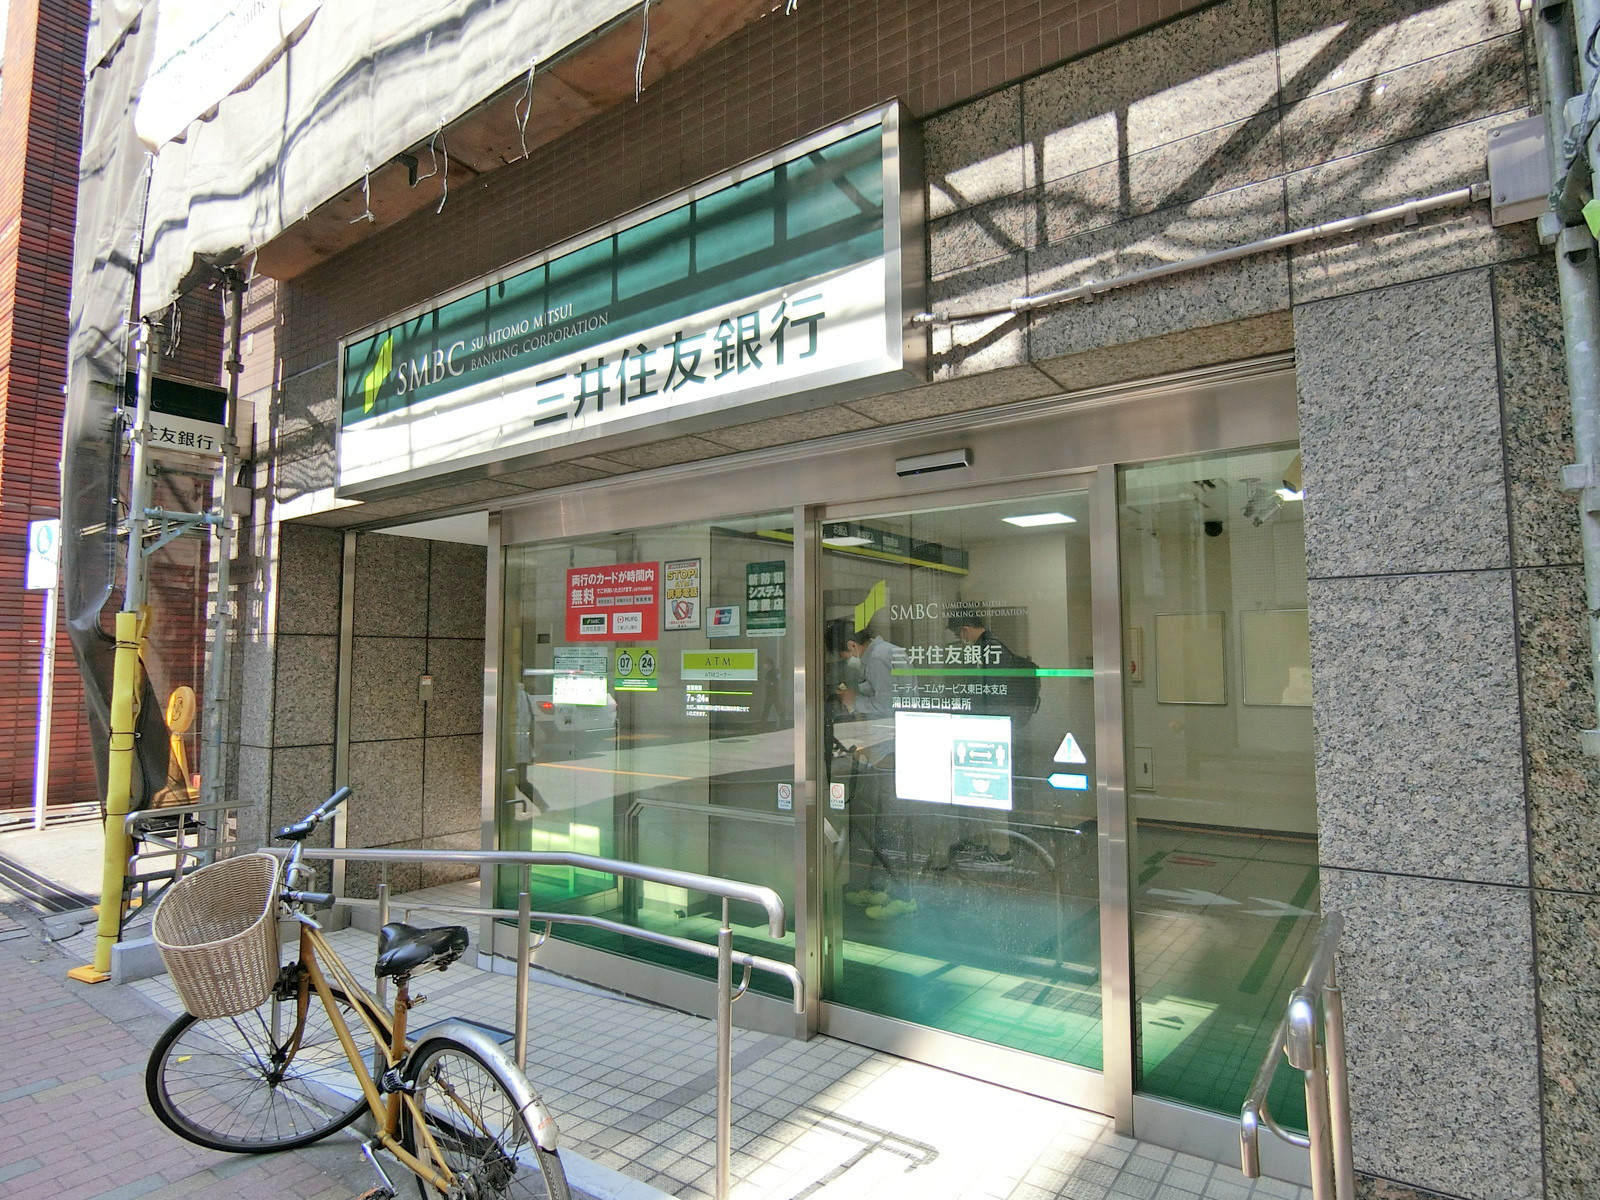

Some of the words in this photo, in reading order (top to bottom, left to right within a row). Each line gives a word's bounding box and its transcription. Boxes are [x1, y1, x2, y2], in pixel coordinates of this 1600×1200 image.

[471, 317, 530, 350] SUMITOMO
[532, 303, 575, 333] MITSUI
[471, 344, 520, 372] BANKING
[522, 312, 609, 356] CORPORATION
[533, 292, 826, 427] 三井住友銀行
[396, 341, 466, 397] SMBC
[572, 568, 654, 587] 両行のカードが時間内
[667, 569, 698, 580] STOP!
[748, 572, 784, 586] 新防犯
[572, 588, 595, 605] 無料
[667, 587, 698, 599] 携帯電話
[748, 586, 784, 599] システム
[748, 598, 784, 612] 設置店
[891, 603, 938, 621] SMBC
[942, 601, 980, 609] SUMITOMO
[976, 608, 1029, 617] CORPORATION
[704, 657, 731, 667] ATM
[891, 645, 1002, 665] 三井住友銀行
[620, 658, 631, 669] 07
[641, 657, 652, 668] 24
[892, 684, 1008, 695] エーティーエムサービス東日本支店
